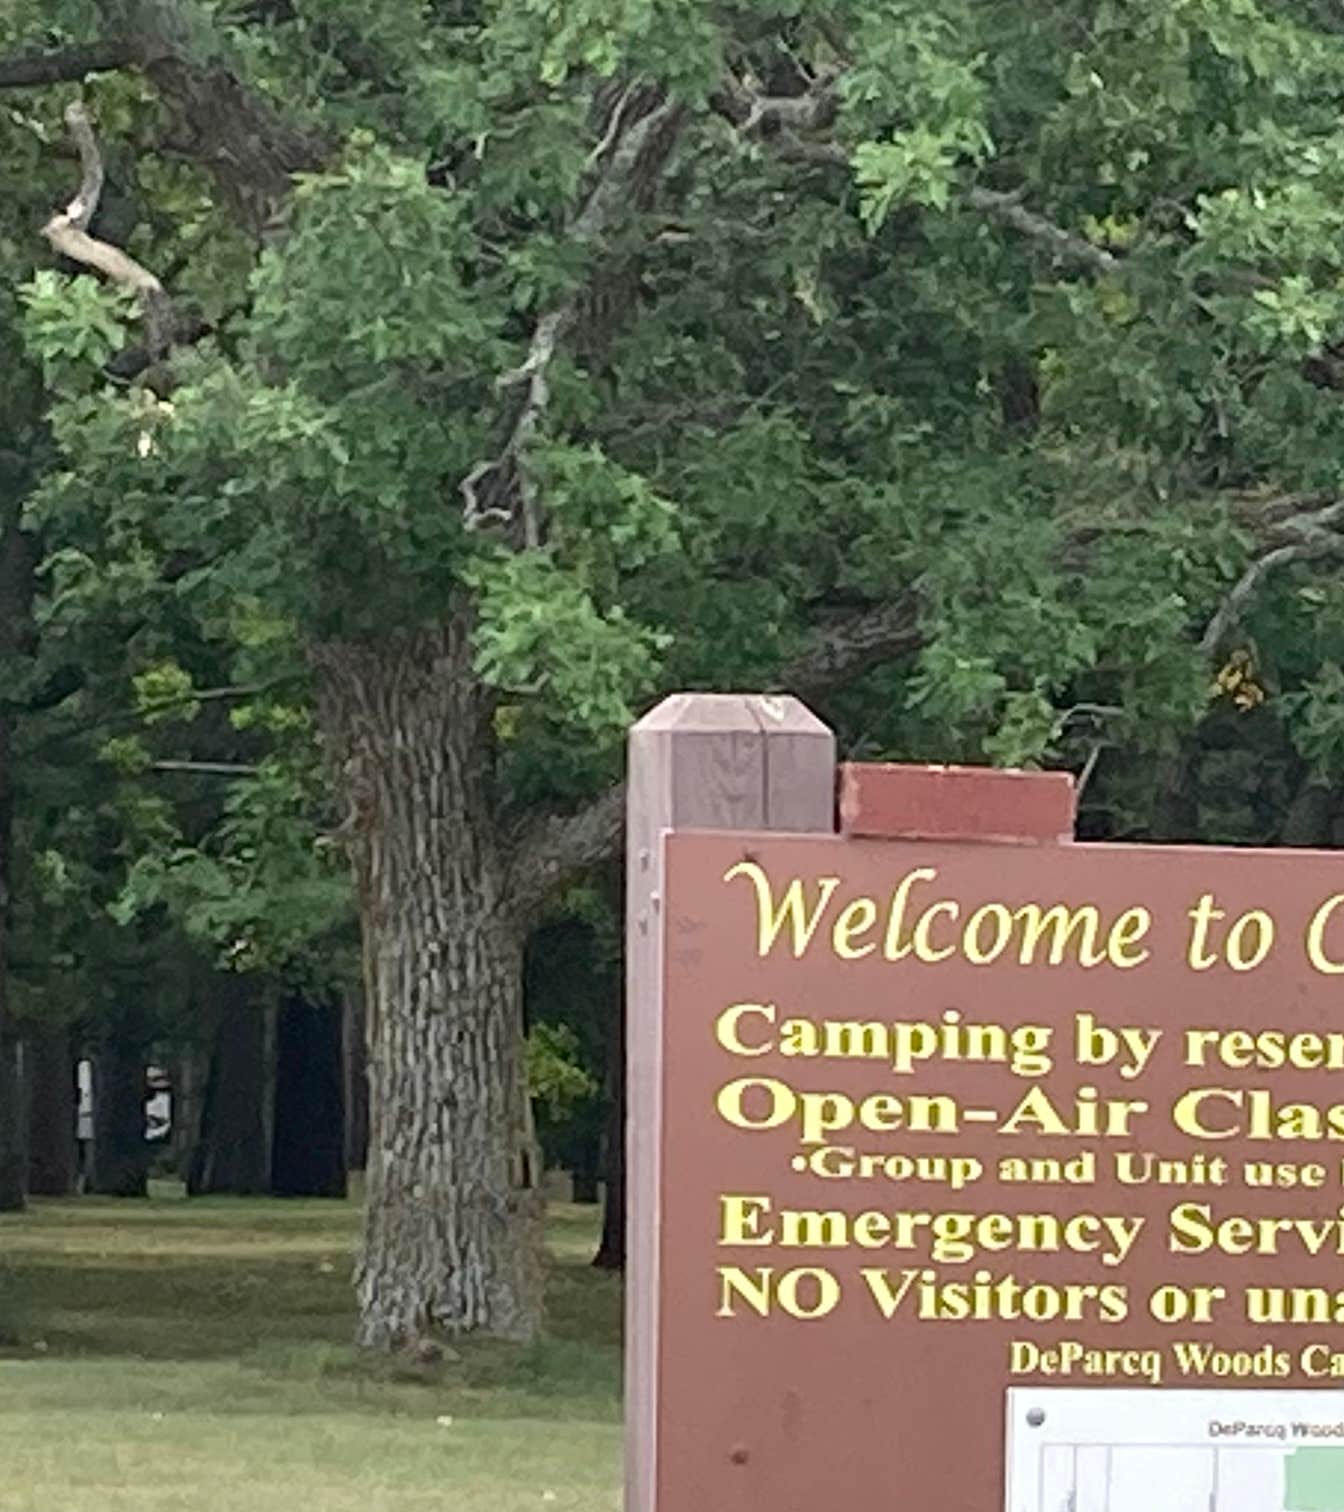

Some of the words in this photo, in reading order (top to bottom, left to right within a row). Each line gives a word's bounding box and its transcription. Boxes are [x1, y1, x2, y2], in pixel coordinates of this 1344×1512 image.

[724, 863, 1151, 967] Welcome
[1188, 895, 1274, 970] to
[716, 1004, 1053, 1077] Camping
[1076, 1014, 1163, 1078] by
[717, 1078, 1148, 1145] Open-Air
[999, 1151, 1095, 1183] and
[1114, 1152, 1227, 1186] Unit
[1244, 1163, 1326, 1188] use
[718, 1194, 1145, 1265] Emergency
[716, 1266, 840, 1318] NO
[860, 1268, 1128, 1322] Visitors
[1150, 1286, 1225, 1322] or
[1010, 1341, 1160, 1383] DeParcq
[1174, 1343, 1289, 1374] Woods
